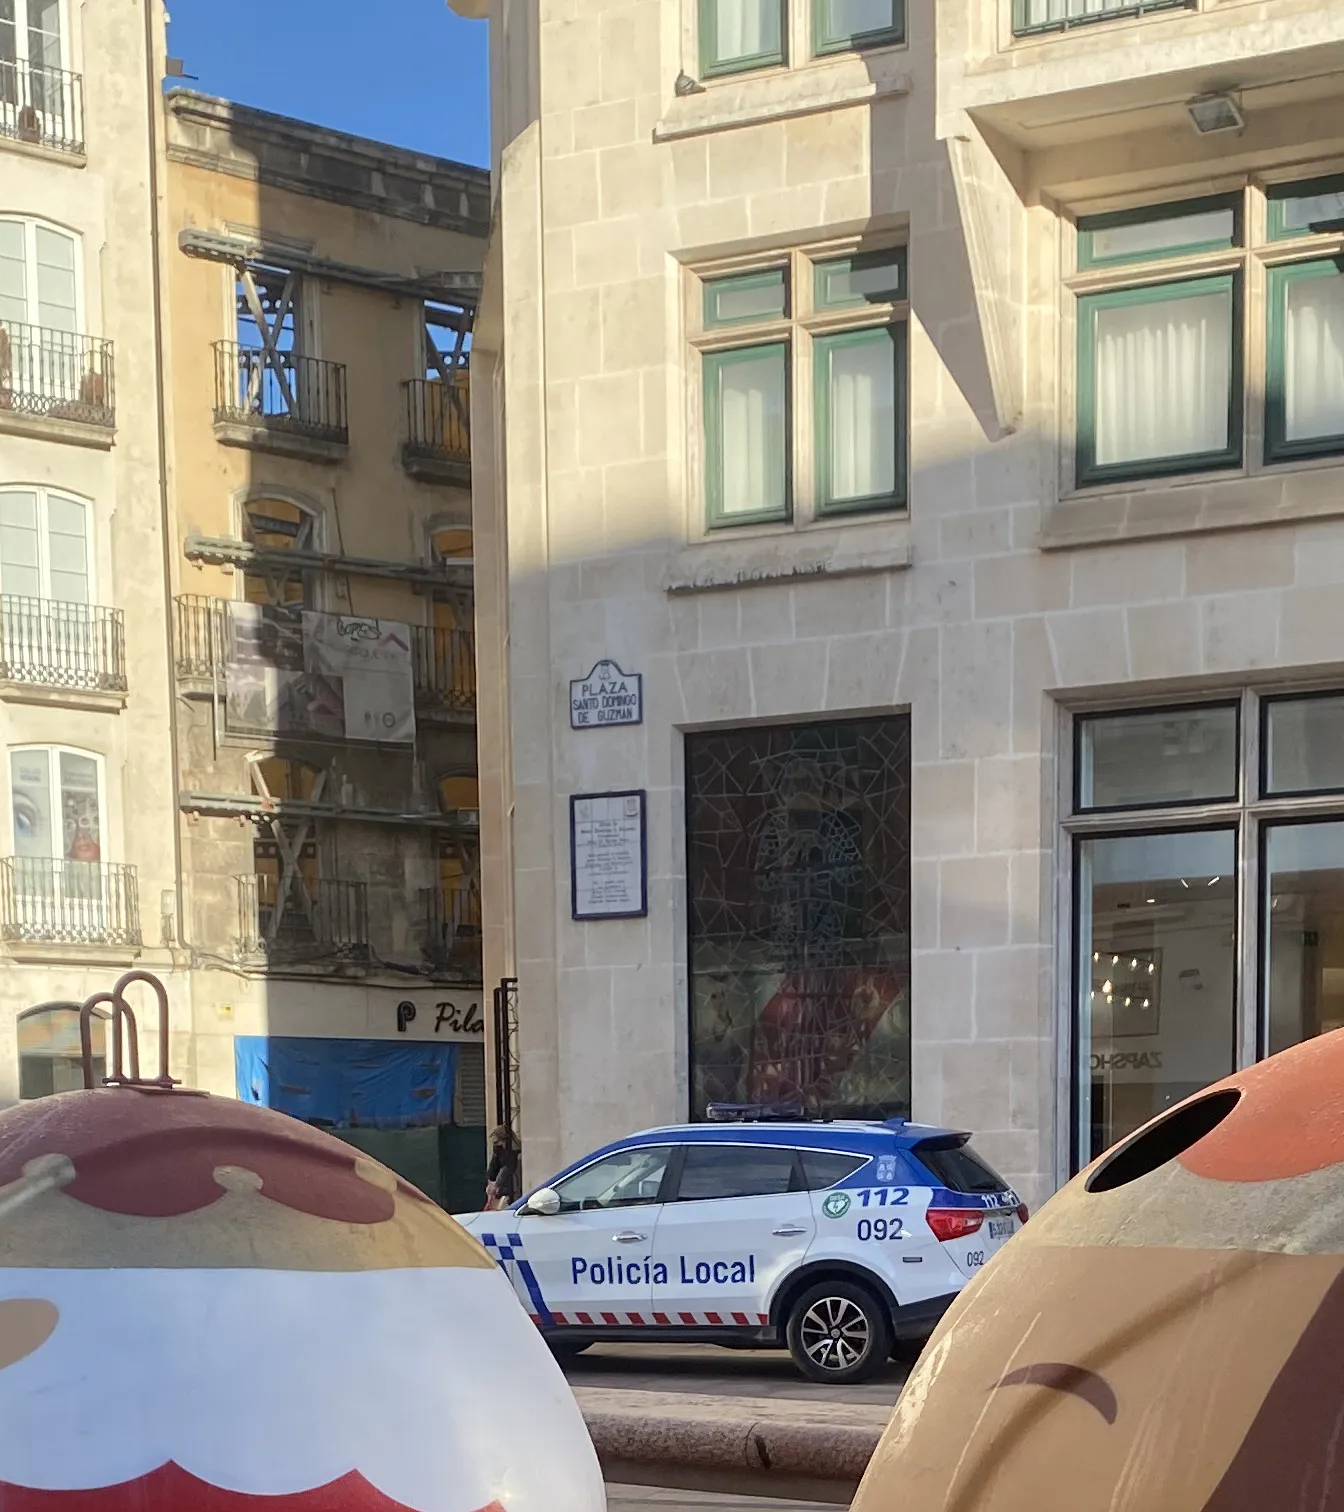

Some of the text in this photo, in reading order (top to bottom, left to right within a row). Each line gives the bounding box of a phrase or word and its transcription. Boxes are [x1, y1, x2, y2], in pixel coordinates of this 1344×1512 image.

[582, 681, 628, 697] PLAZA
[573, 693, 637, 711] SANTO DOMINGO
[577, 711, 590, 724] DE
[857, 1187, 910, 1207] 112
[857, 1217, 903, 1241] 092
[966, 1250, 984, 1267] 092
[571, 1254, 755, 1285] Policía Local
